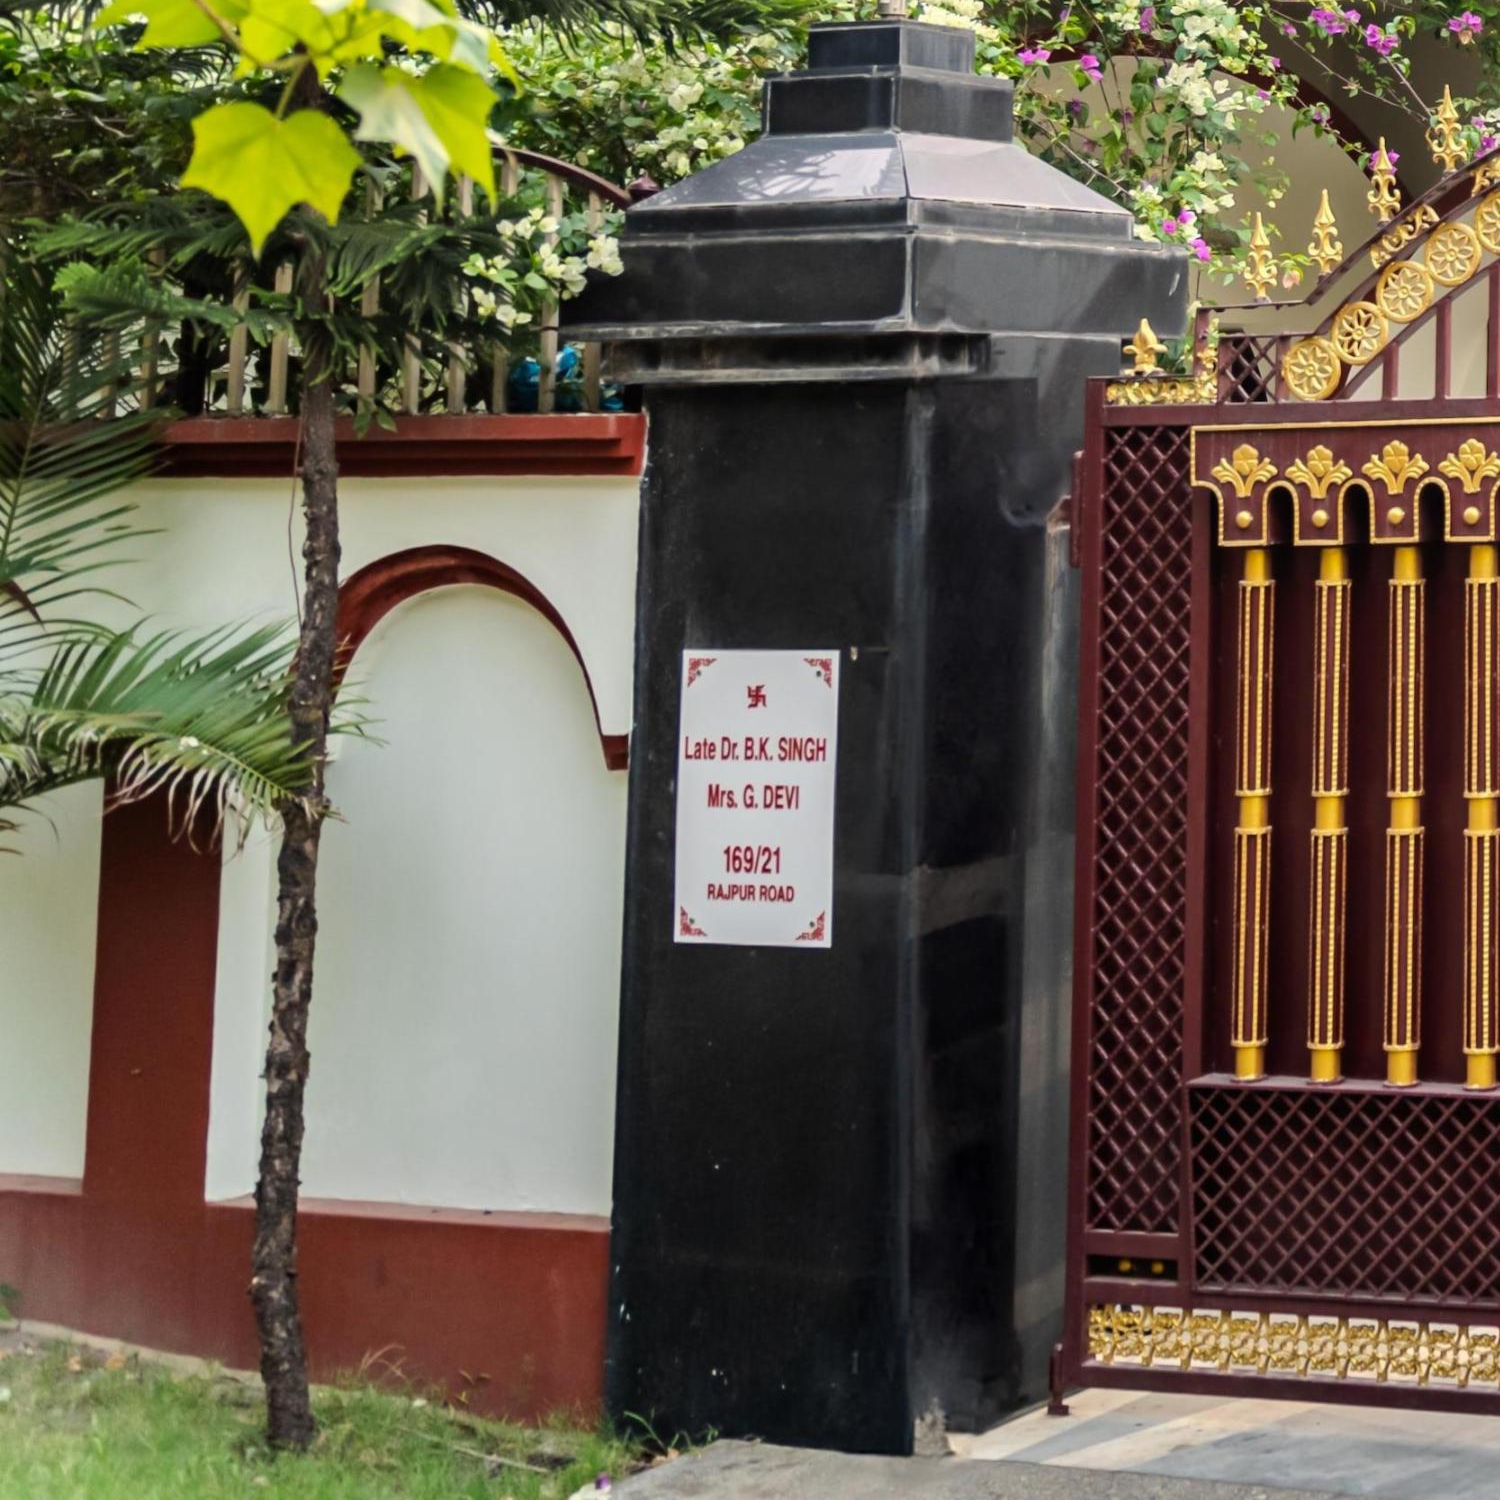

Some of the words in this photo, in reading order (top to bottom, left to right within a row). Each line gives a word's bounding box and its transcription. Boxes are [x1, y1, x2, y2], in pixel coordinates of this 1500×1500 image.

[685, 737, 716, 760] Late
[720, 736, 739, 760] Dr.
[744, 737, 773, 760] B.K.
[778, 737, 827, 762] SINGH
[707, 784, 737, 809] Mrs.
[743, 784, 758, 809] G.
[763, 785, 799, 810] DEVI
[723, 846, 781, 874] 169/21
[707, 884, 755, 901] RAJPUR
[759, 885, 794, 902] ROAD
